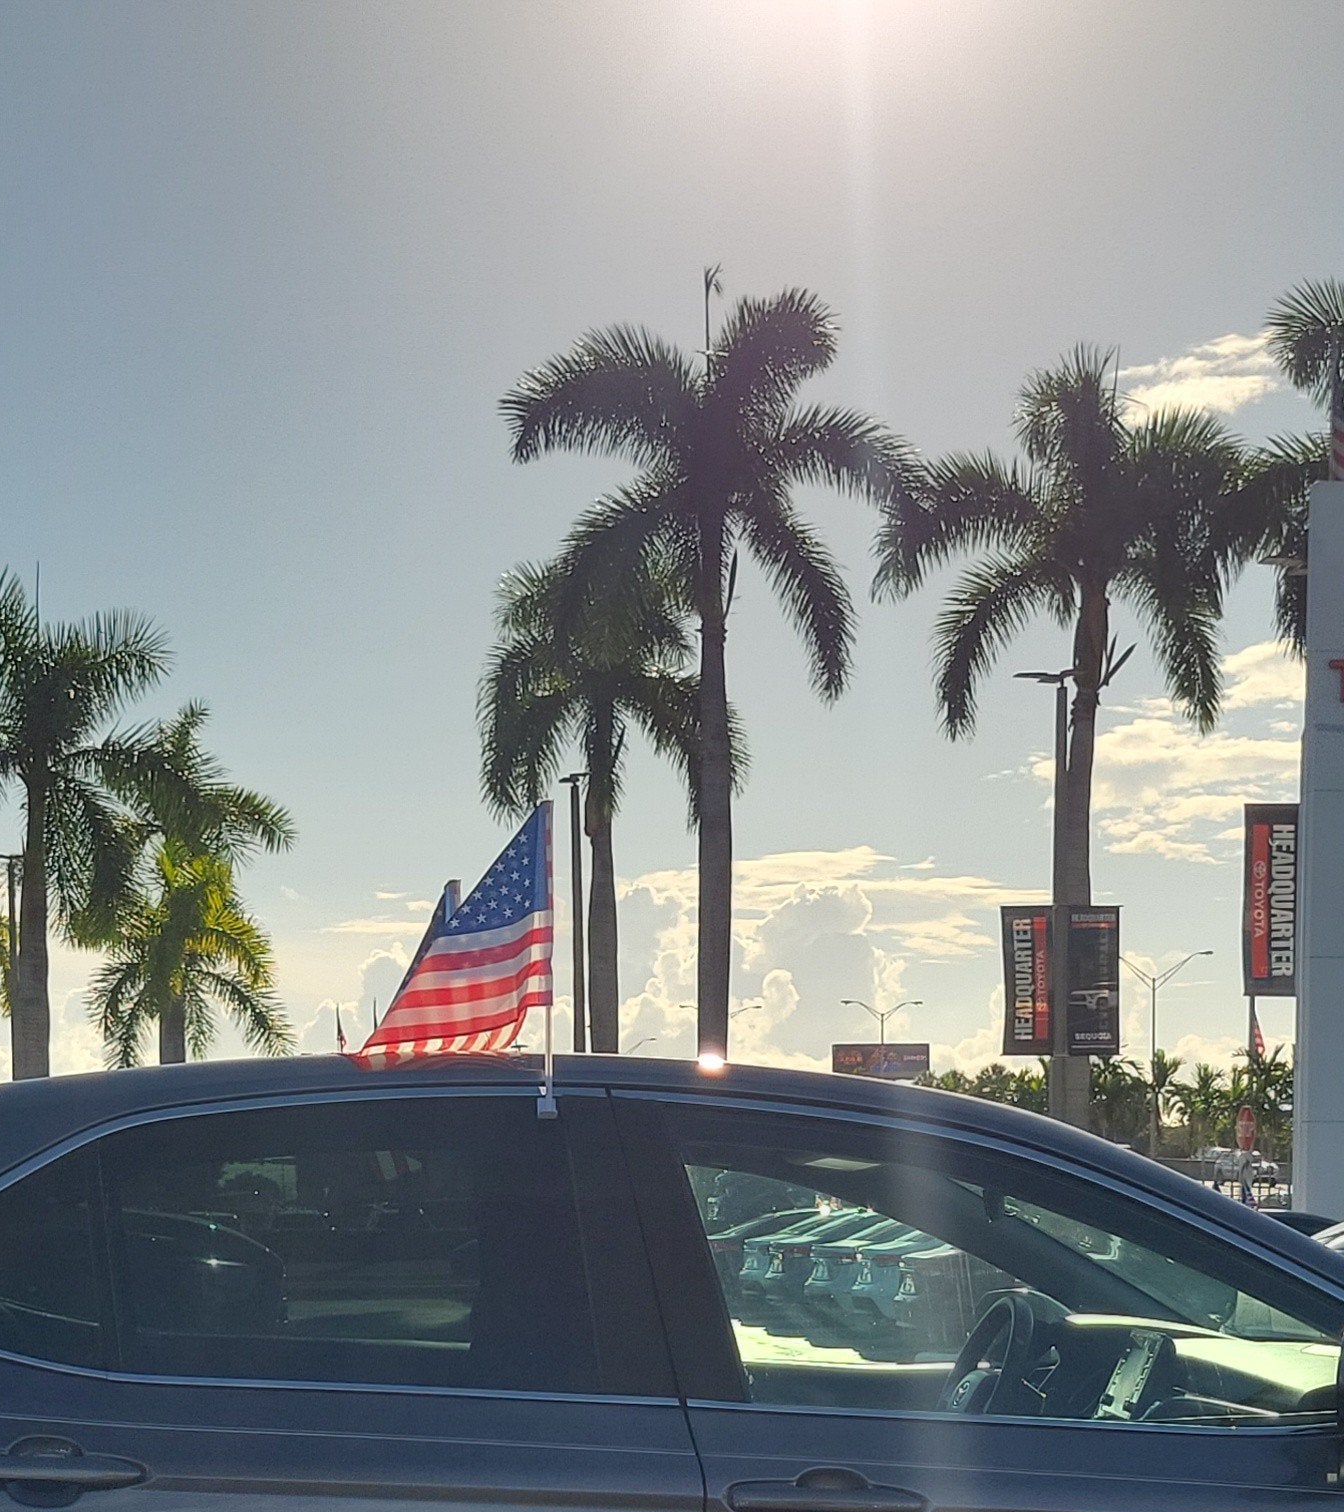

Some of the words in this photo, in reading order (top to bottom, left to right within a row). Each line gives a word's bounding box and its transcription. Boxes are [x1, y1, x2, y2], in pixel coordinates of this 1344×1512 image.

[1254, 883, 1265, 938] TOYOTA
[1267, 824, 1296, 978] HEADQUARTER
[1013, 918, 1035, 1040] HEADQUARTER
